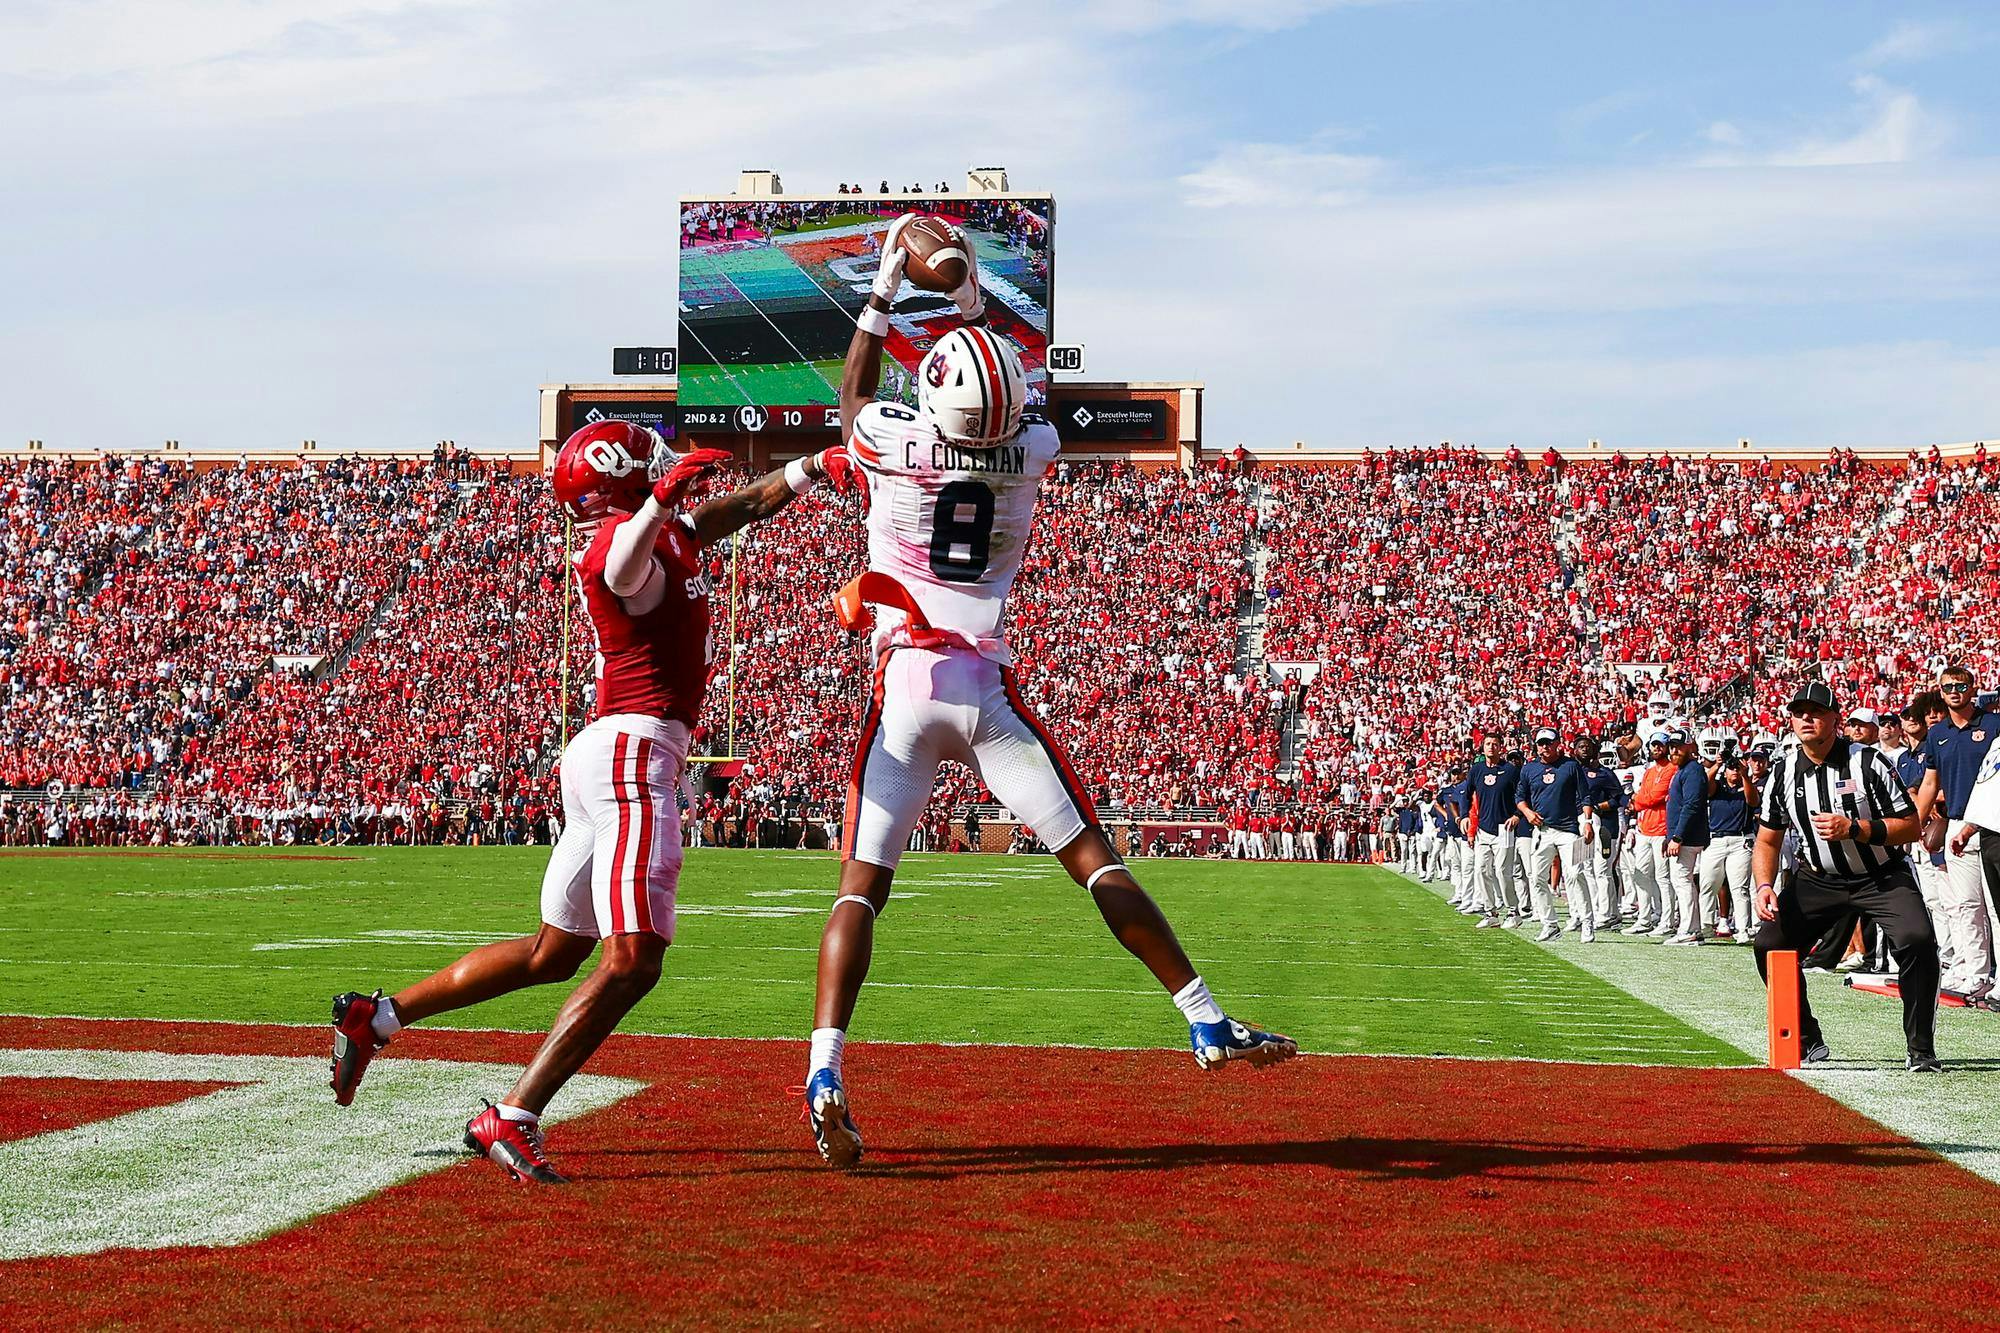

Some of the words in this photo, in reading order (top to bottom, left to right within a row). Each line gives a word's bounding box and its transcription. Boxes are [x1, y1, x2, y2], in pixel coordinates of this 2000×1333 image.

[638, 352, 672, 370] 1:10
[1053, 349, 1078, 367] 40
[684, 413, 708, 424] 2ND
[709, 413, 718, 424] &
[719, 413, 726, 424] 2
[740, 405, 762, 431] OU
[783, 411, 802, 426] 10
[880, 407, 916, 421] 8
[1097, 411, 1129, 419] Executive
[1129, 411, 1152, 419] Homes
[955, 438, 983, 447] WAR
[584, 440, 633, 477] OU
[906, 441, 921, 469] C.
[931, 441, 1026, 475] COLEMAN
[929, 480, 996, 583] 8
[1287, 667, 1302, 680] 20
[1795, 786, 1804, 798] S
[1001, 810, 1009, 819] 19
